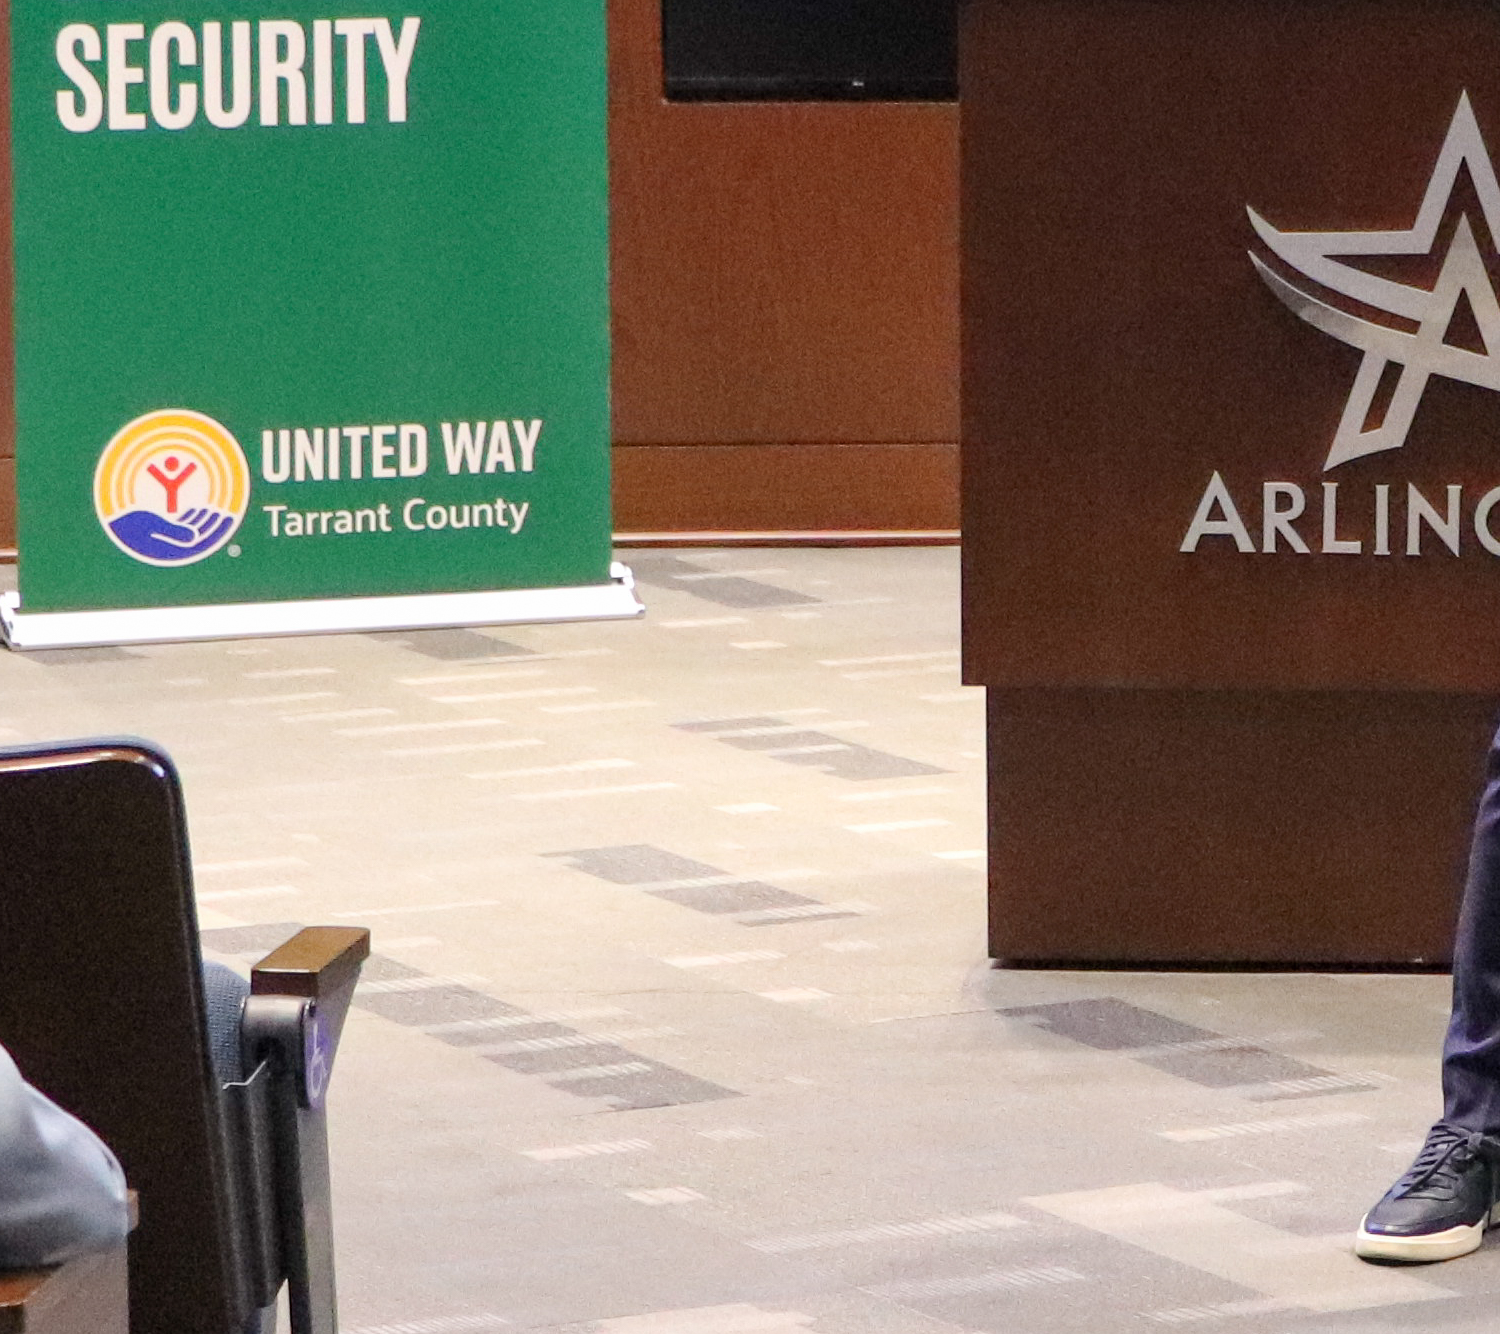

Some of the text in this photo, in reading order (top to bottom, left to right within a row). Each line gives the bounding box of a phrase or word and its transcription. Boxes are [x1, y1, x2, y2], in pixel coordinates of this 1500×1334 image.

[56, 17, 420, 132] SECURITY
[262, 419, 542, 483] UNITED WAY
[263, 498, 528, 536] Tarrant County
